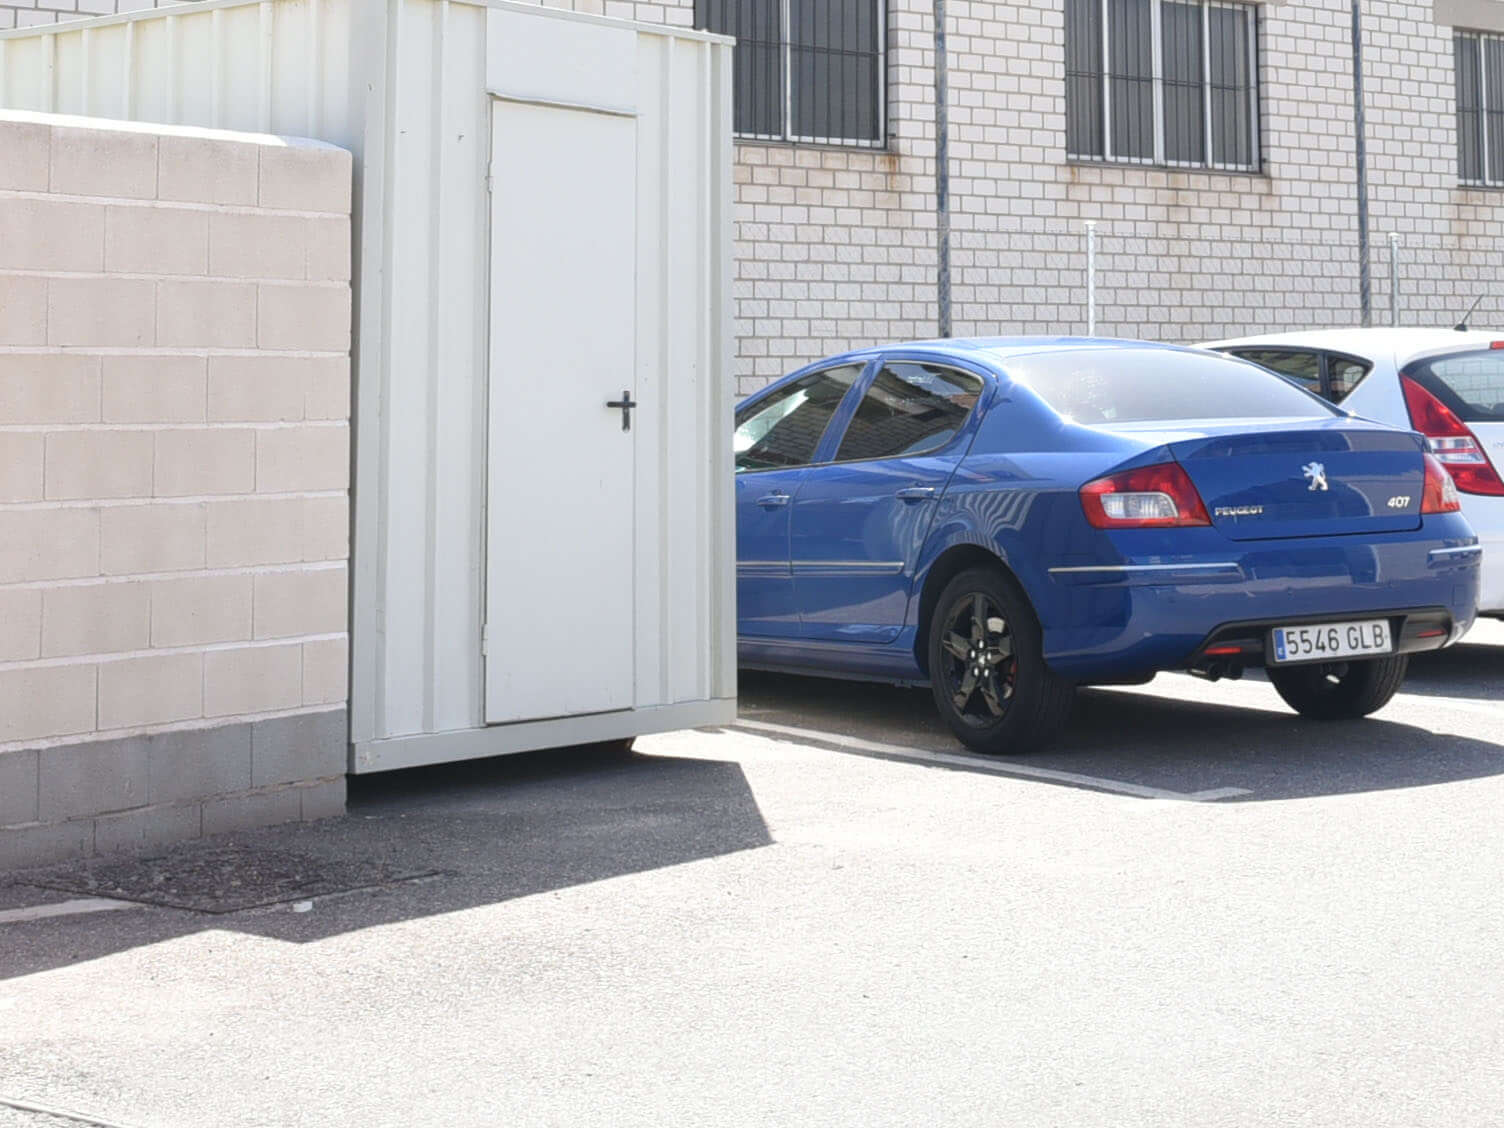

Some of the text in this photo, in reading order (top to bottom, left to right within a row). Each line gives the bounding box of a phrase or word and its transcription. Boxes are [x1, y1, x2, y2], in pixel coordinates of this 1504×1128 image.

[1387, 496, 1410, 508] 407
[1215, 505, 1264, 517] PEUGEOT
[1286, 624, 1385, 655] 5546 GLB
